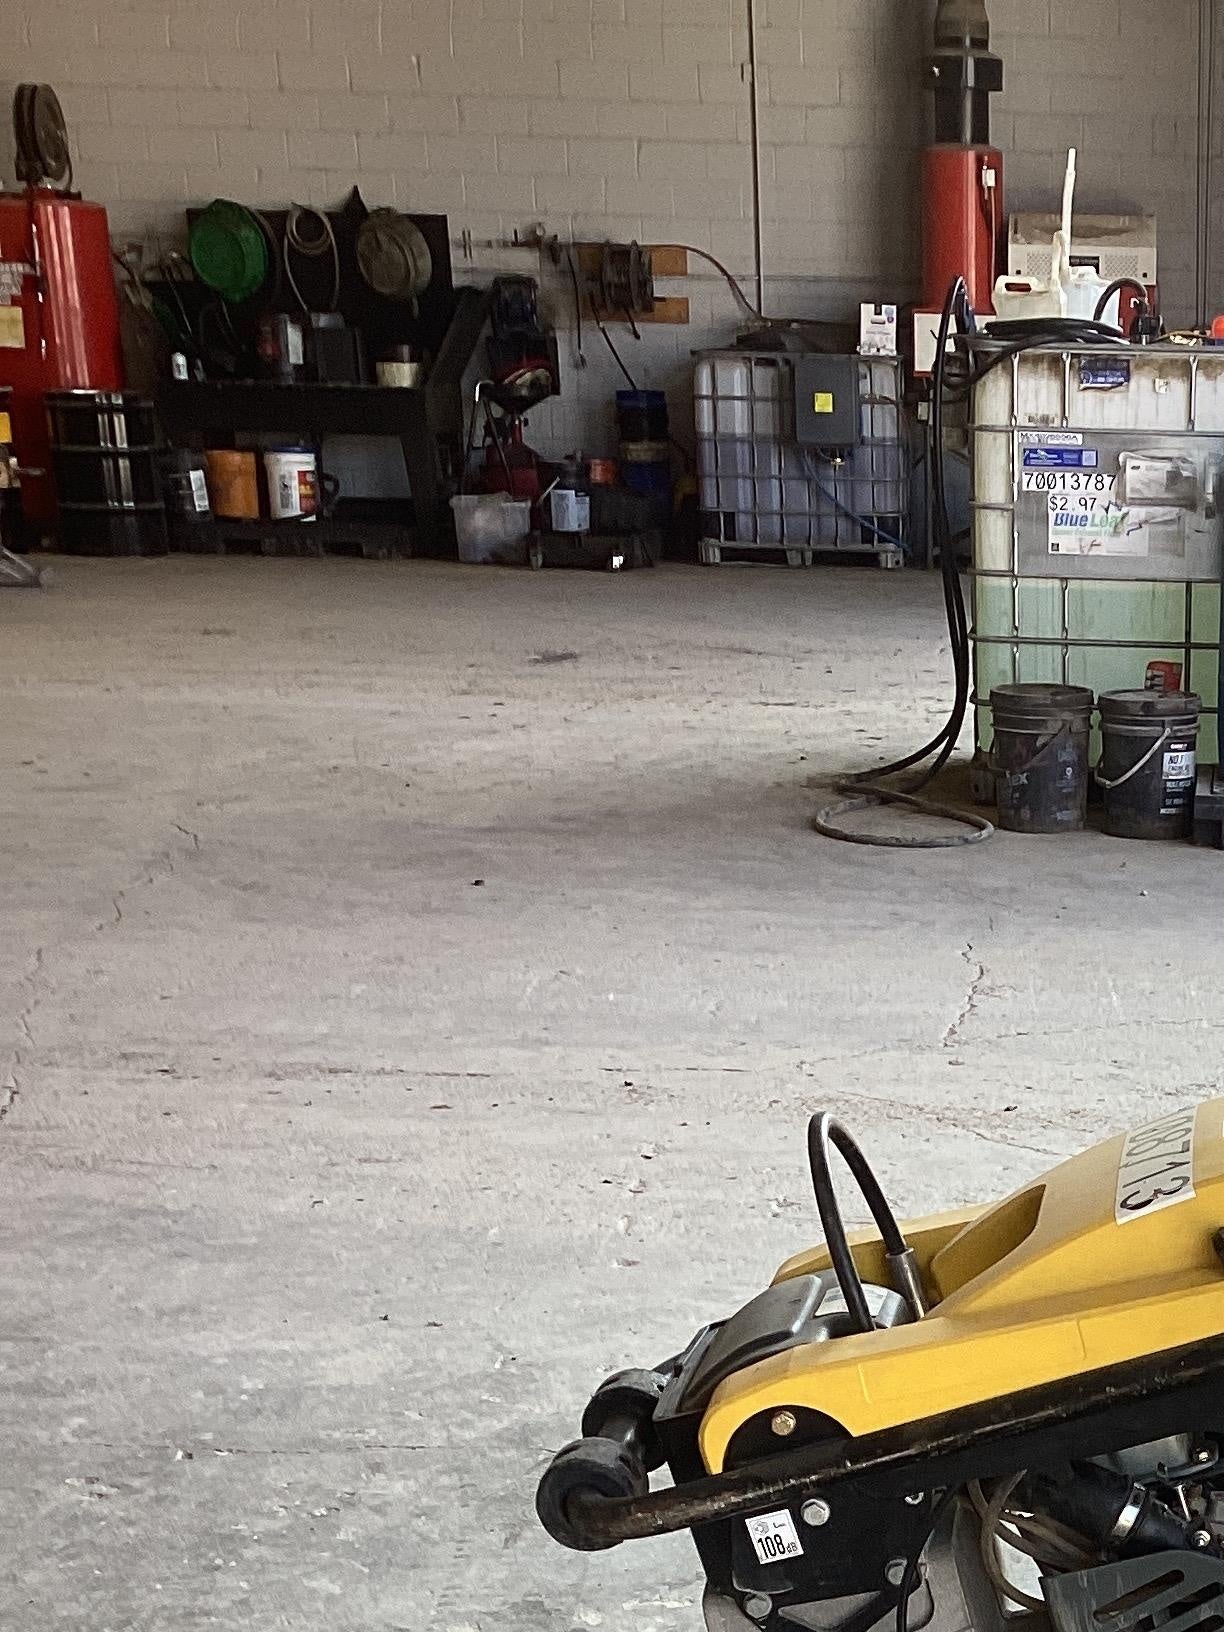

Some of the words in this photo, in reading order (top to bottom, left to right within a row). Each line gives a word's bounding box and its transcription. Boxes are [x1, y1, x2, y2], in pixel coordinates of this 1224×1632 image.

[1024, 472, 1117, 491] 70013787
[1049, 496, 1097, 513] $2.97
[1053, 512, 1089, 527] Blue
[757, 1533, 786, 1559] 108
